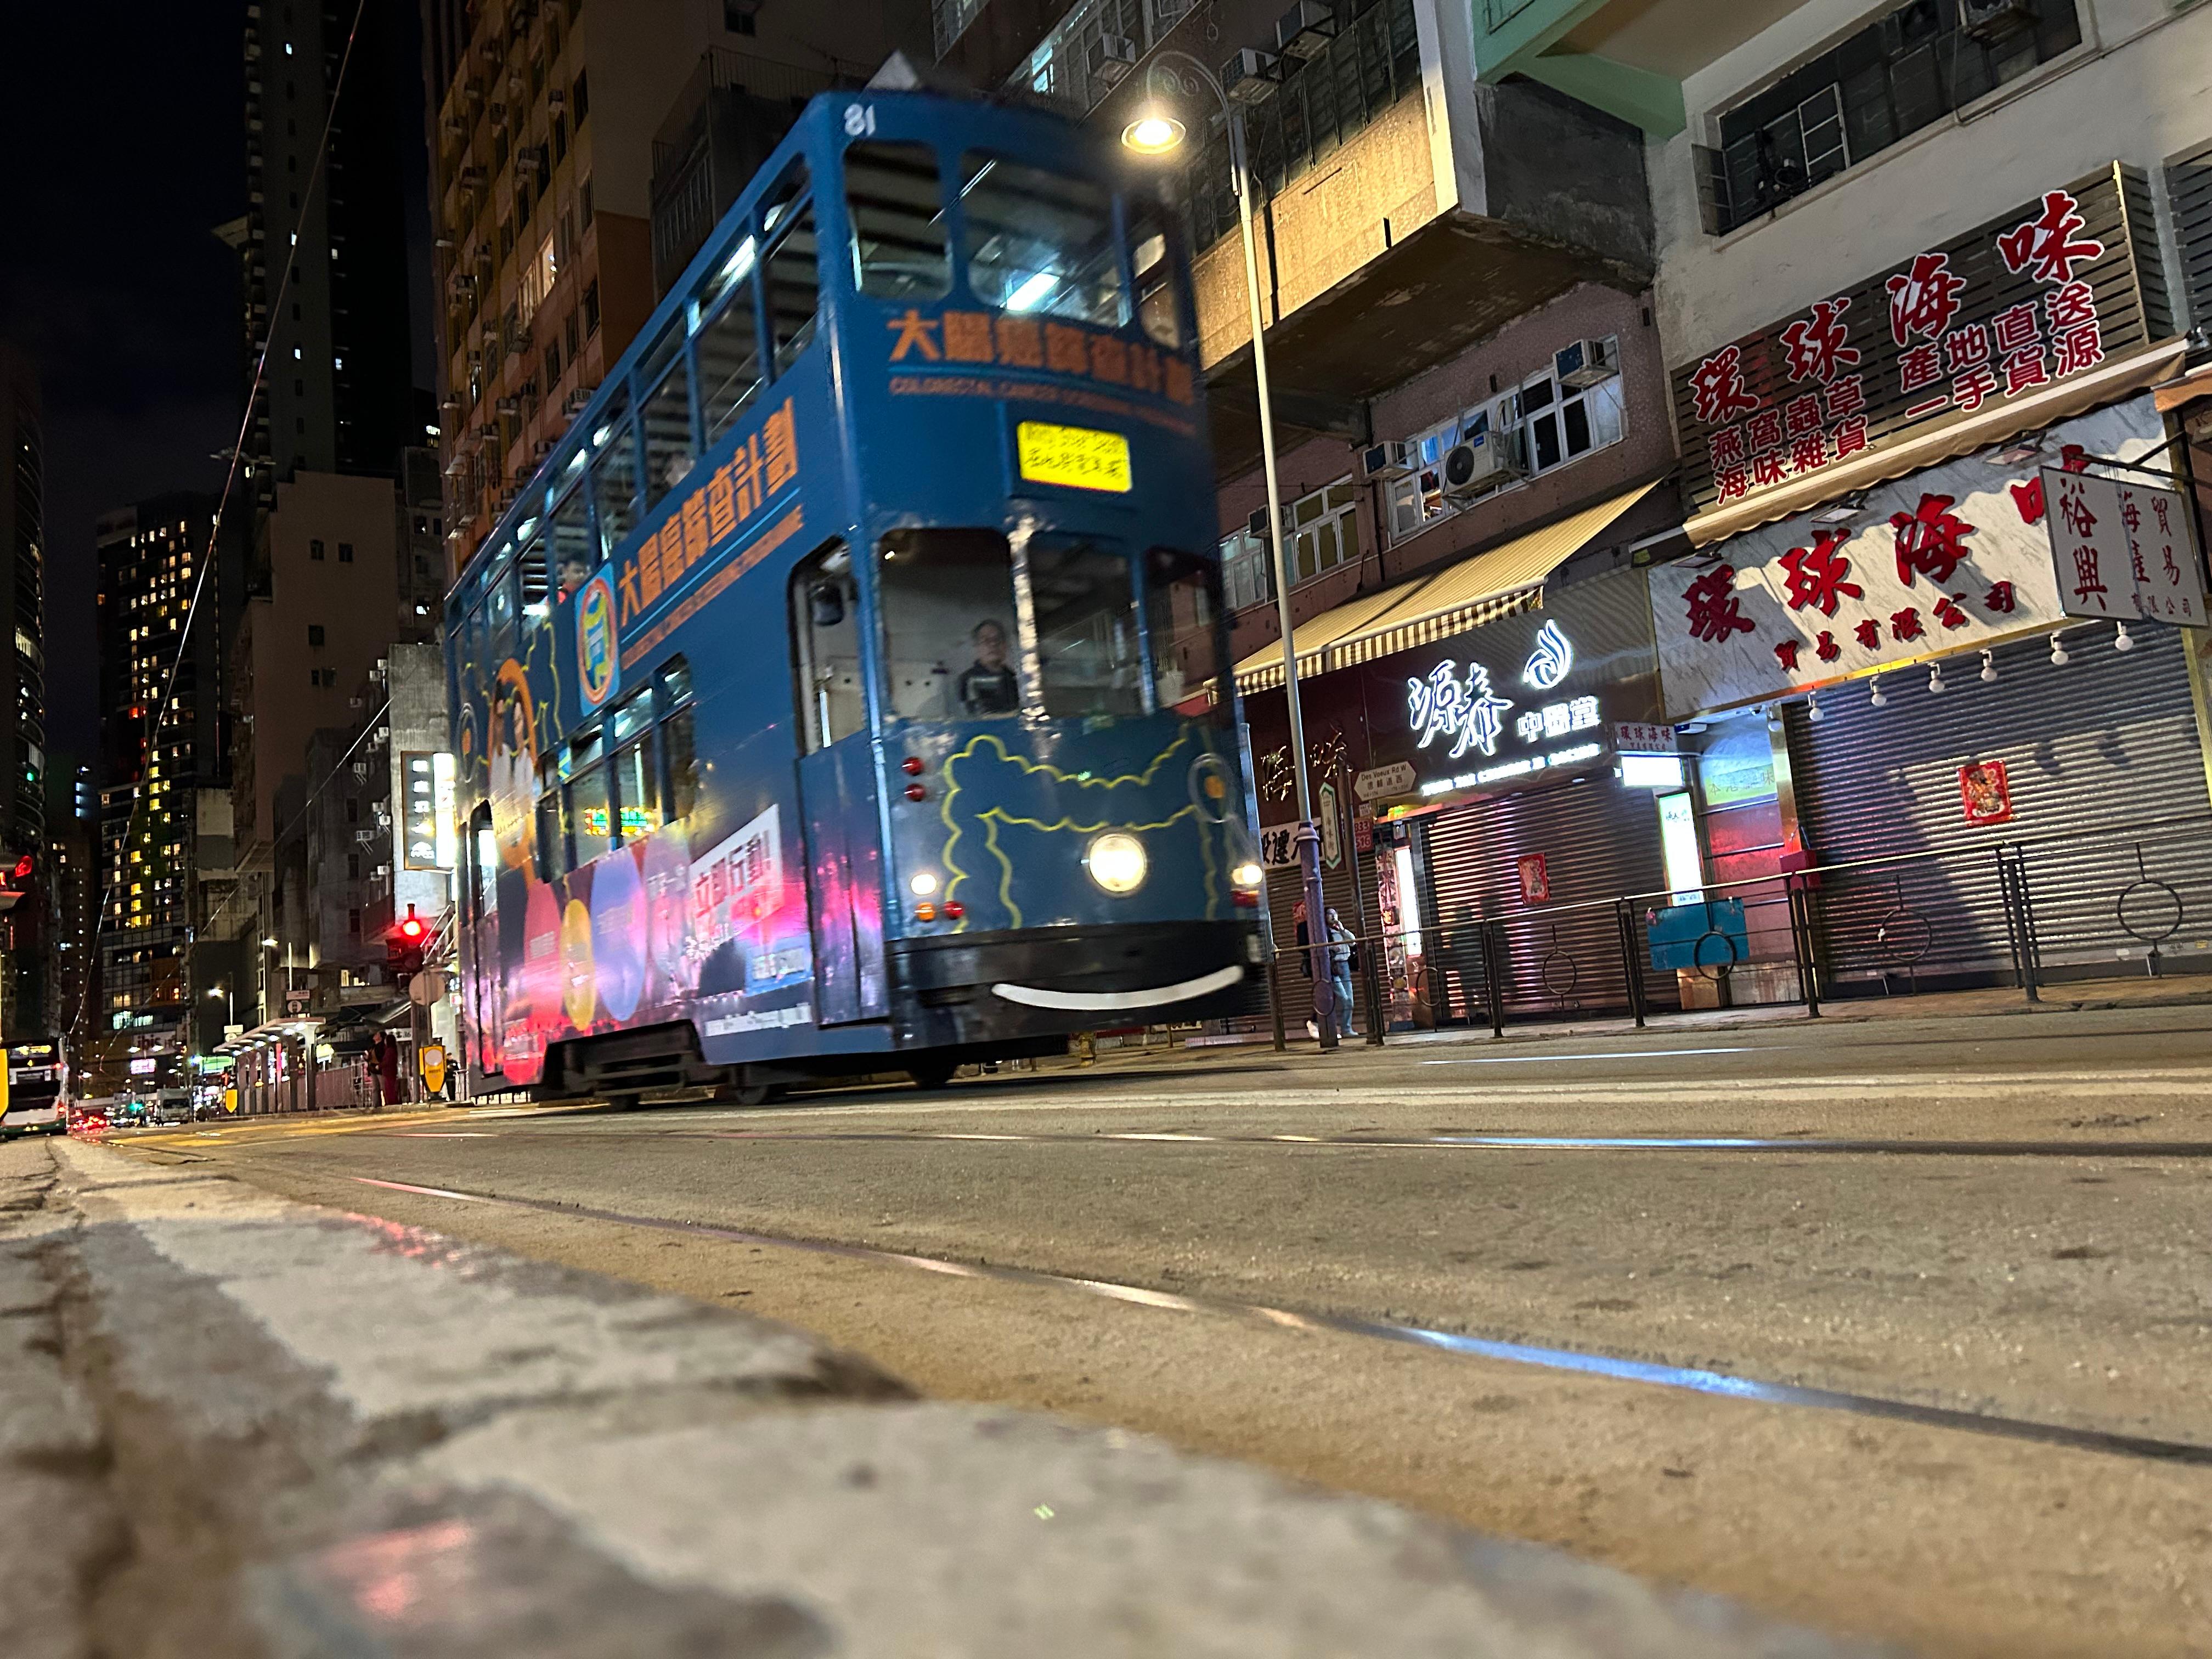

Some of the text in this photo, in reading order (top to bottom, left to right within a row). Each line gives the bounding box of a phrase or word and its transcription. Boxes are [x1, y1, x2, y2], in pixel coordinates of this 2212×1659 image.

[844, 103, 876, 137] 81
[1688, 189, 2104, 424] 環球海味
[1898, 281, 2097, 393] 產地直送
[1905, 320, 2104, 419] 一手貨源
[1708, 374, 1865, 470] 燕窩蟲草
[1714, 415, 1869, 506] 海味雜貨
[2059, 478, 2108, 611] 裕興
[2151, 496, 2180, 586] 貿易
[1774, 581, 2016, 672] 貿易有限公司
